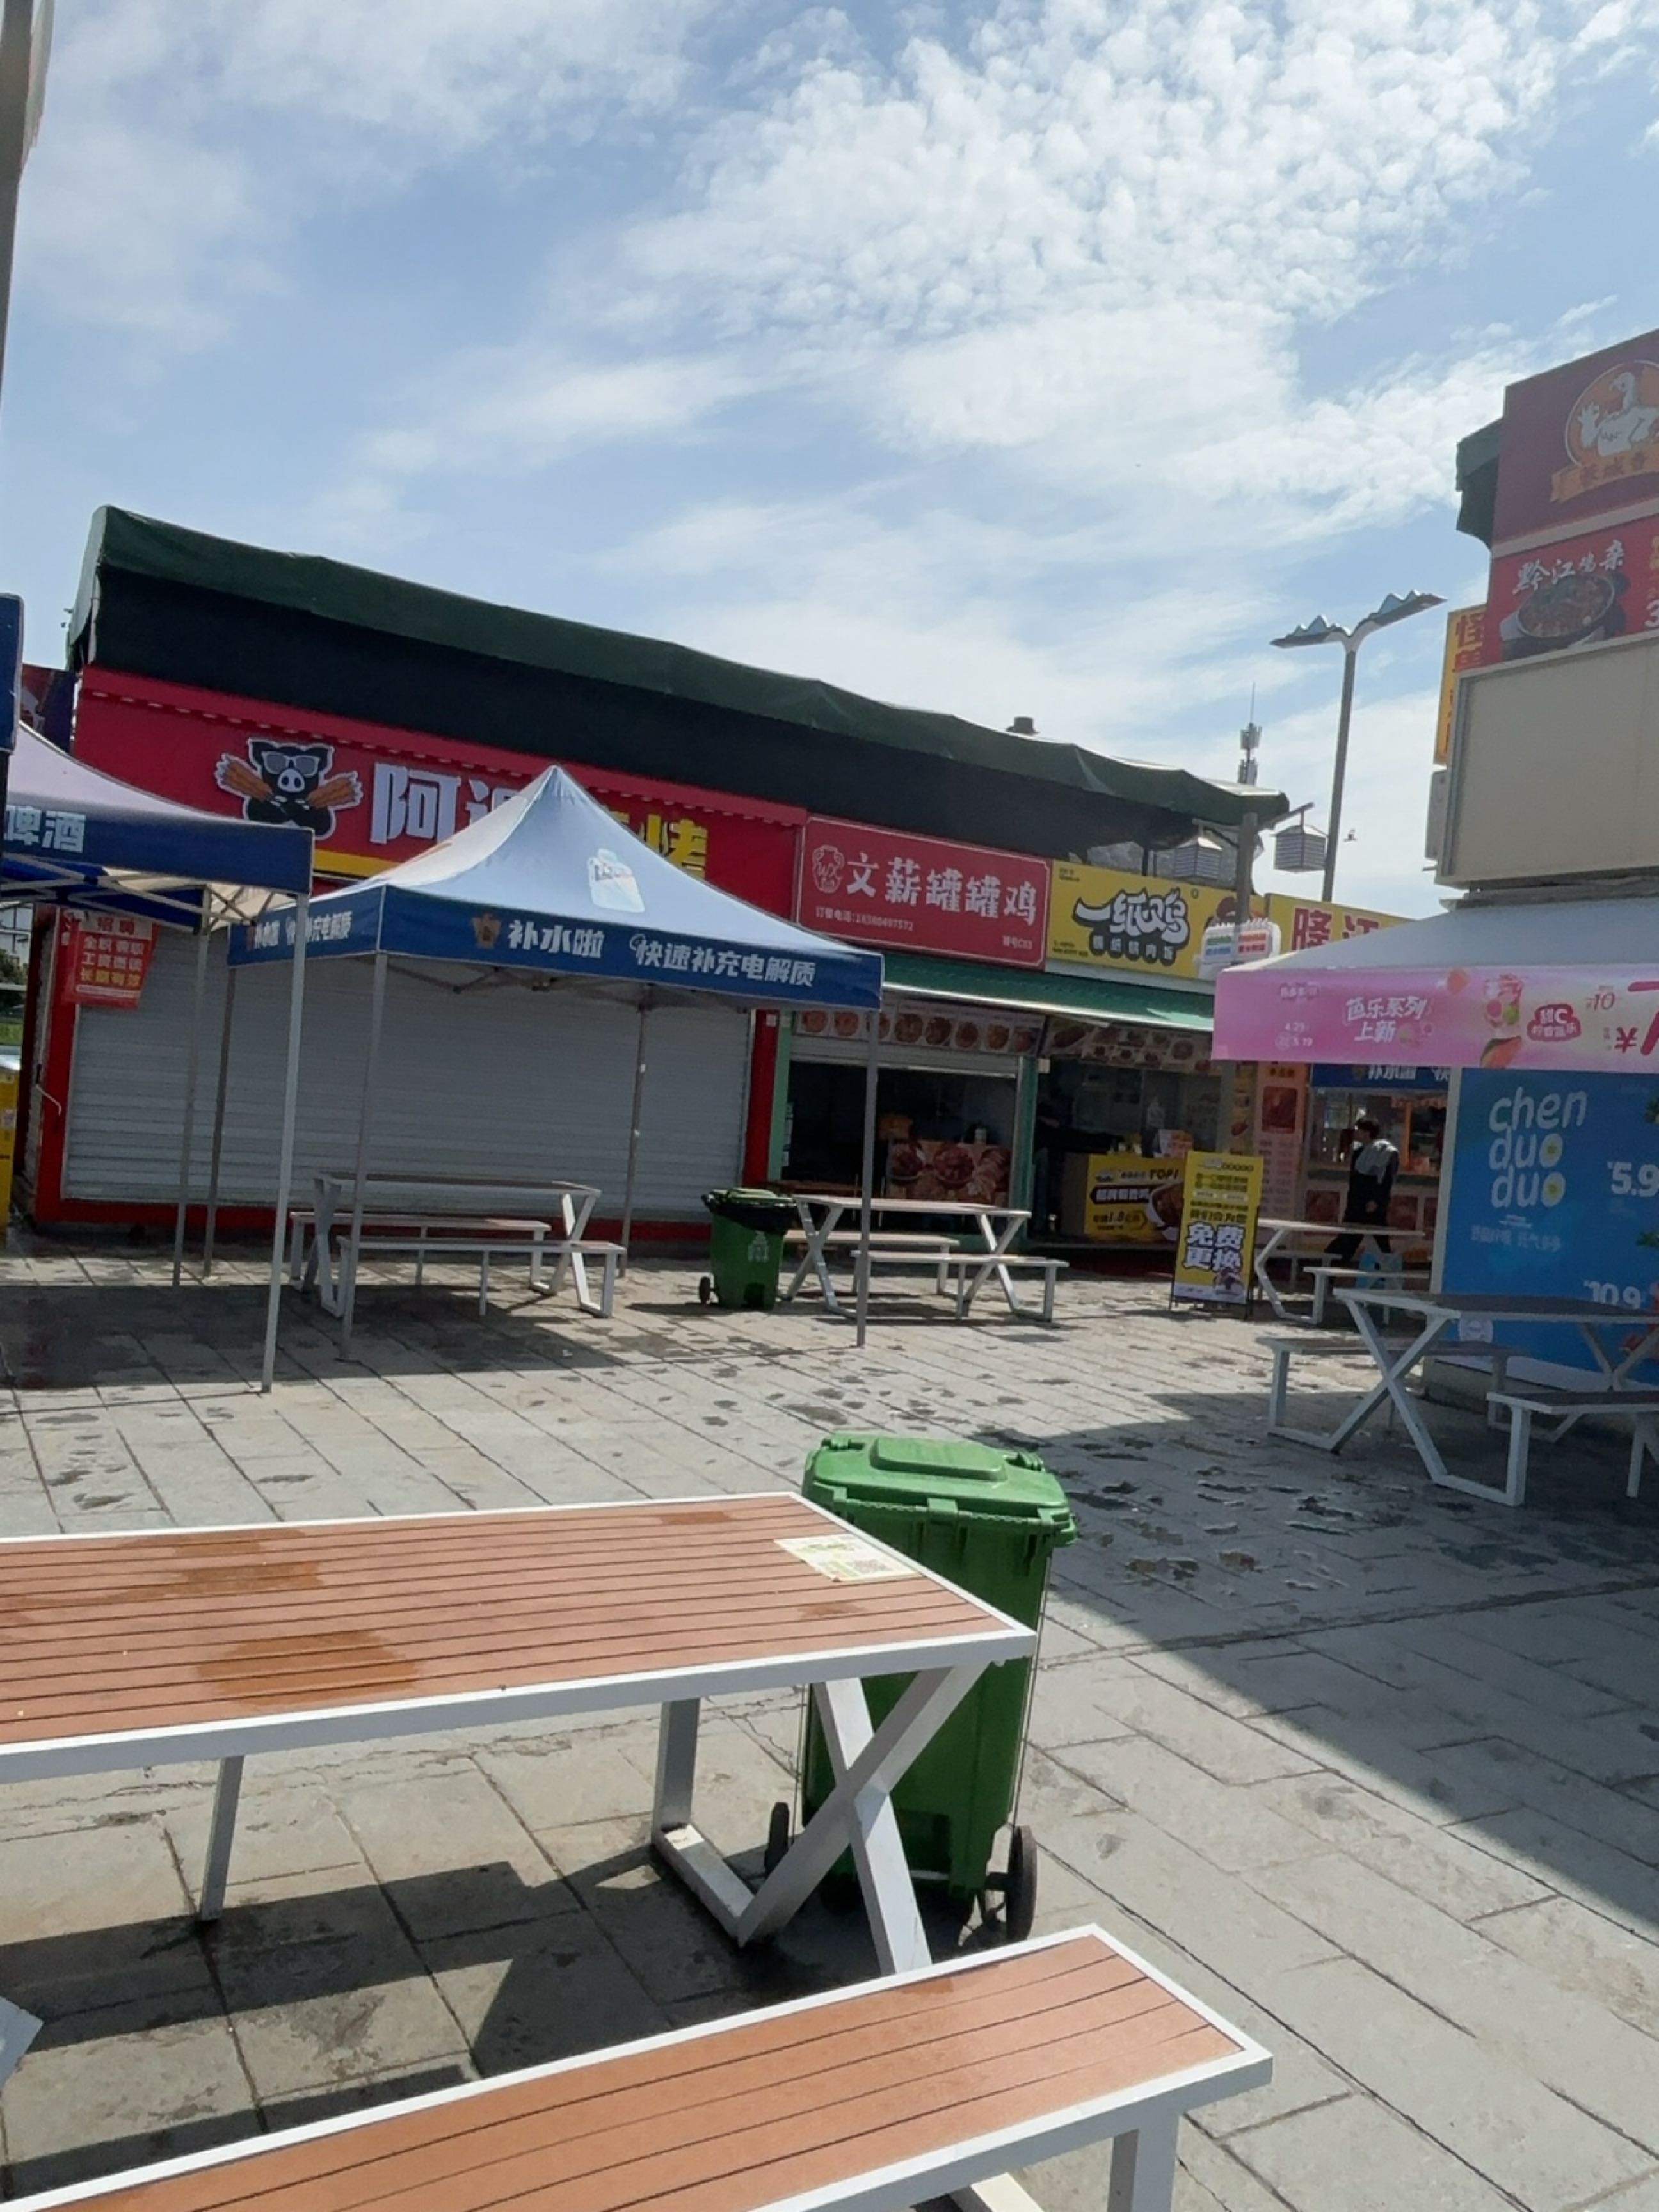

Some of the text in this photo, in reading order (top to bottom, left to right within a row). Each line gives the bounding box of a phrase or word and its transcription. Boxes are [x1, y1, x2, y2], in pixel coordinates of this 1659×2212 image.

[846, 852, 1037, 926] 文薪罐罐鸡
[508, 919, 817, 988] 补水啦 快速补充电解质
[1354, 1020, 1397, 1043] 上新
[1489, 1087, 1587, 1133] chen
[1489, 1127, 1564, 1171] duo
[1491, 1165, 1566, 1208] duo
